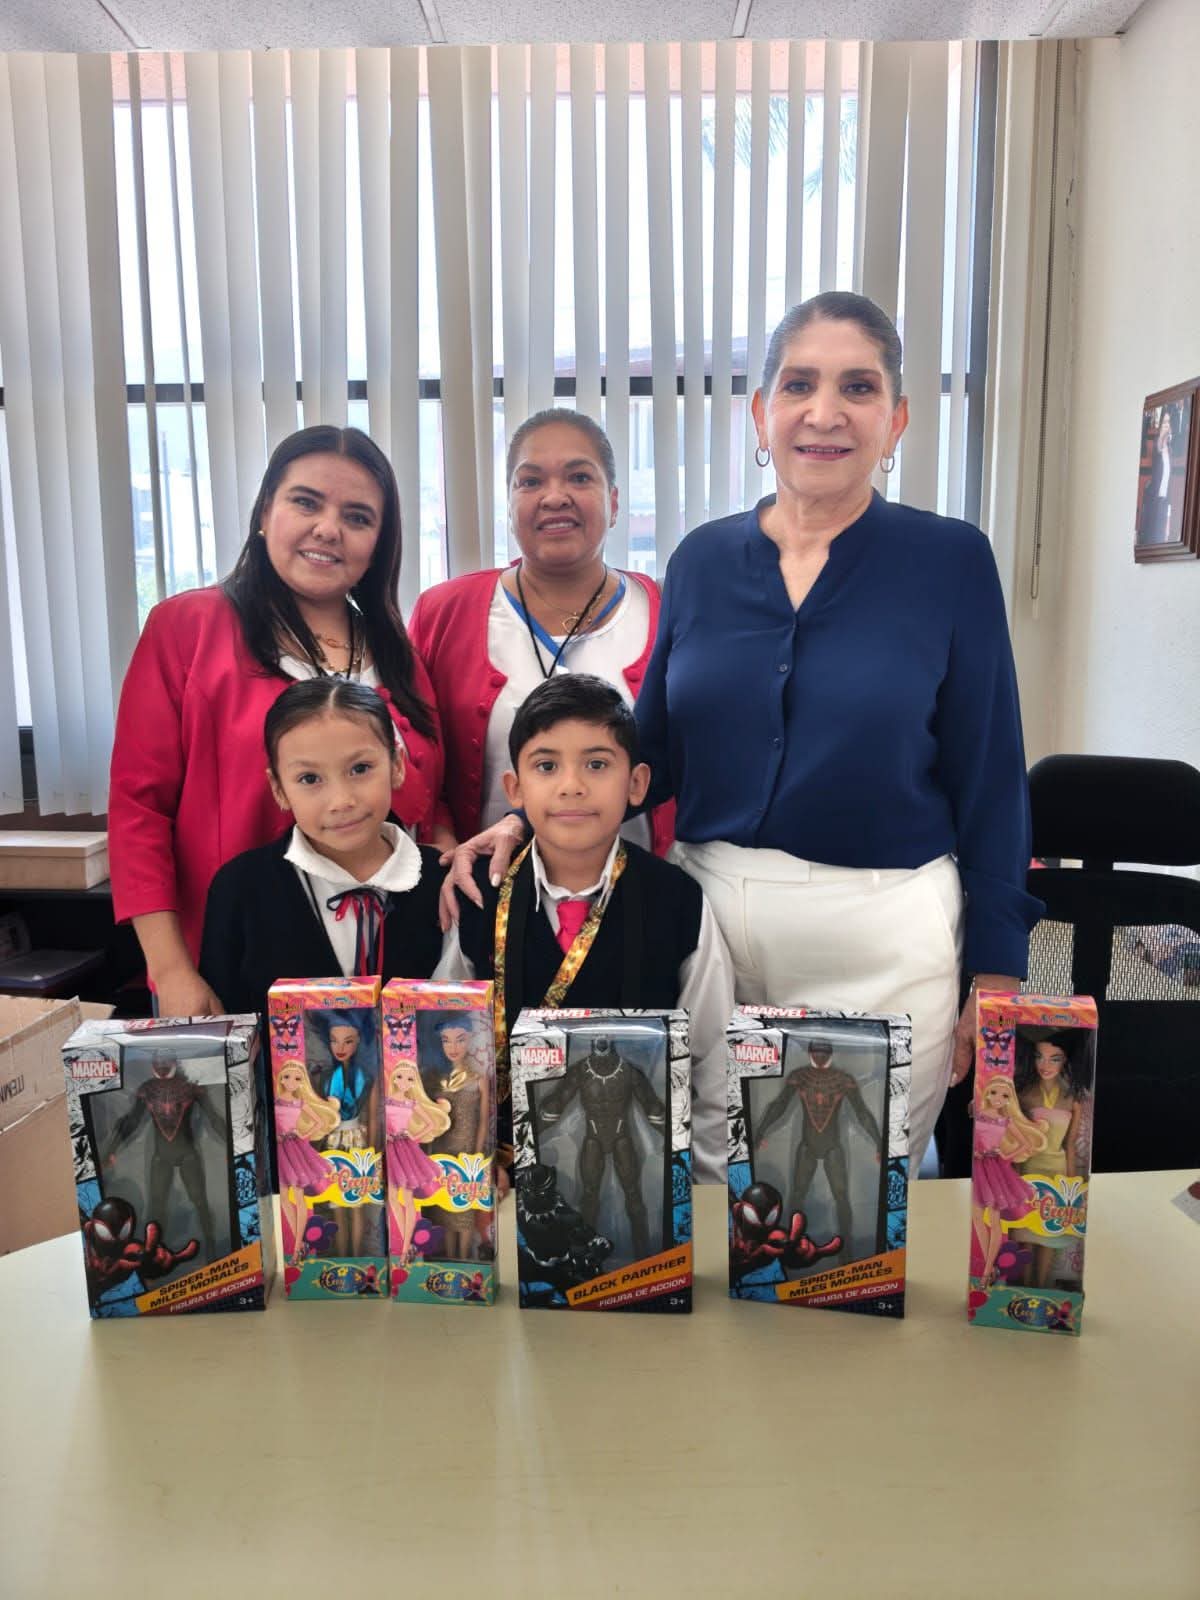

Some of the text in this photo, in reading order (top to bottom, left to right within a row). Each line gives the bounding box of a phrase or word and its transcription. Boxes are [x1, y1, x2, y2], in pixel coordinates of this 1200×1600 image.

[527, 1008, 588, 1018] MARVEL
[741, 1005, 803, 1018] MARVEL
[521, 1048, 562, 1065] MARVEL
[735, 1045, 777, 1064] MARVEL
[72, 1061, 116, 1078] MARVEL
[150, 1262, 249, 1308] MILES MORALES
[573, 1256, 686, 1300] BLACK PANTHER
[789, 1267, 892, 1298] MILES MORALES
[170, 1276, 256, 1312] FIGURA DE ACCION
[239, 1297, 254, 1305] 3+
[599, 1277, 687, 1307] FIGURA DE ACCION
[808, 1282, 898, 1305] FIGURA DE ACCION
[878, 1302, 893, 1310] 3+
